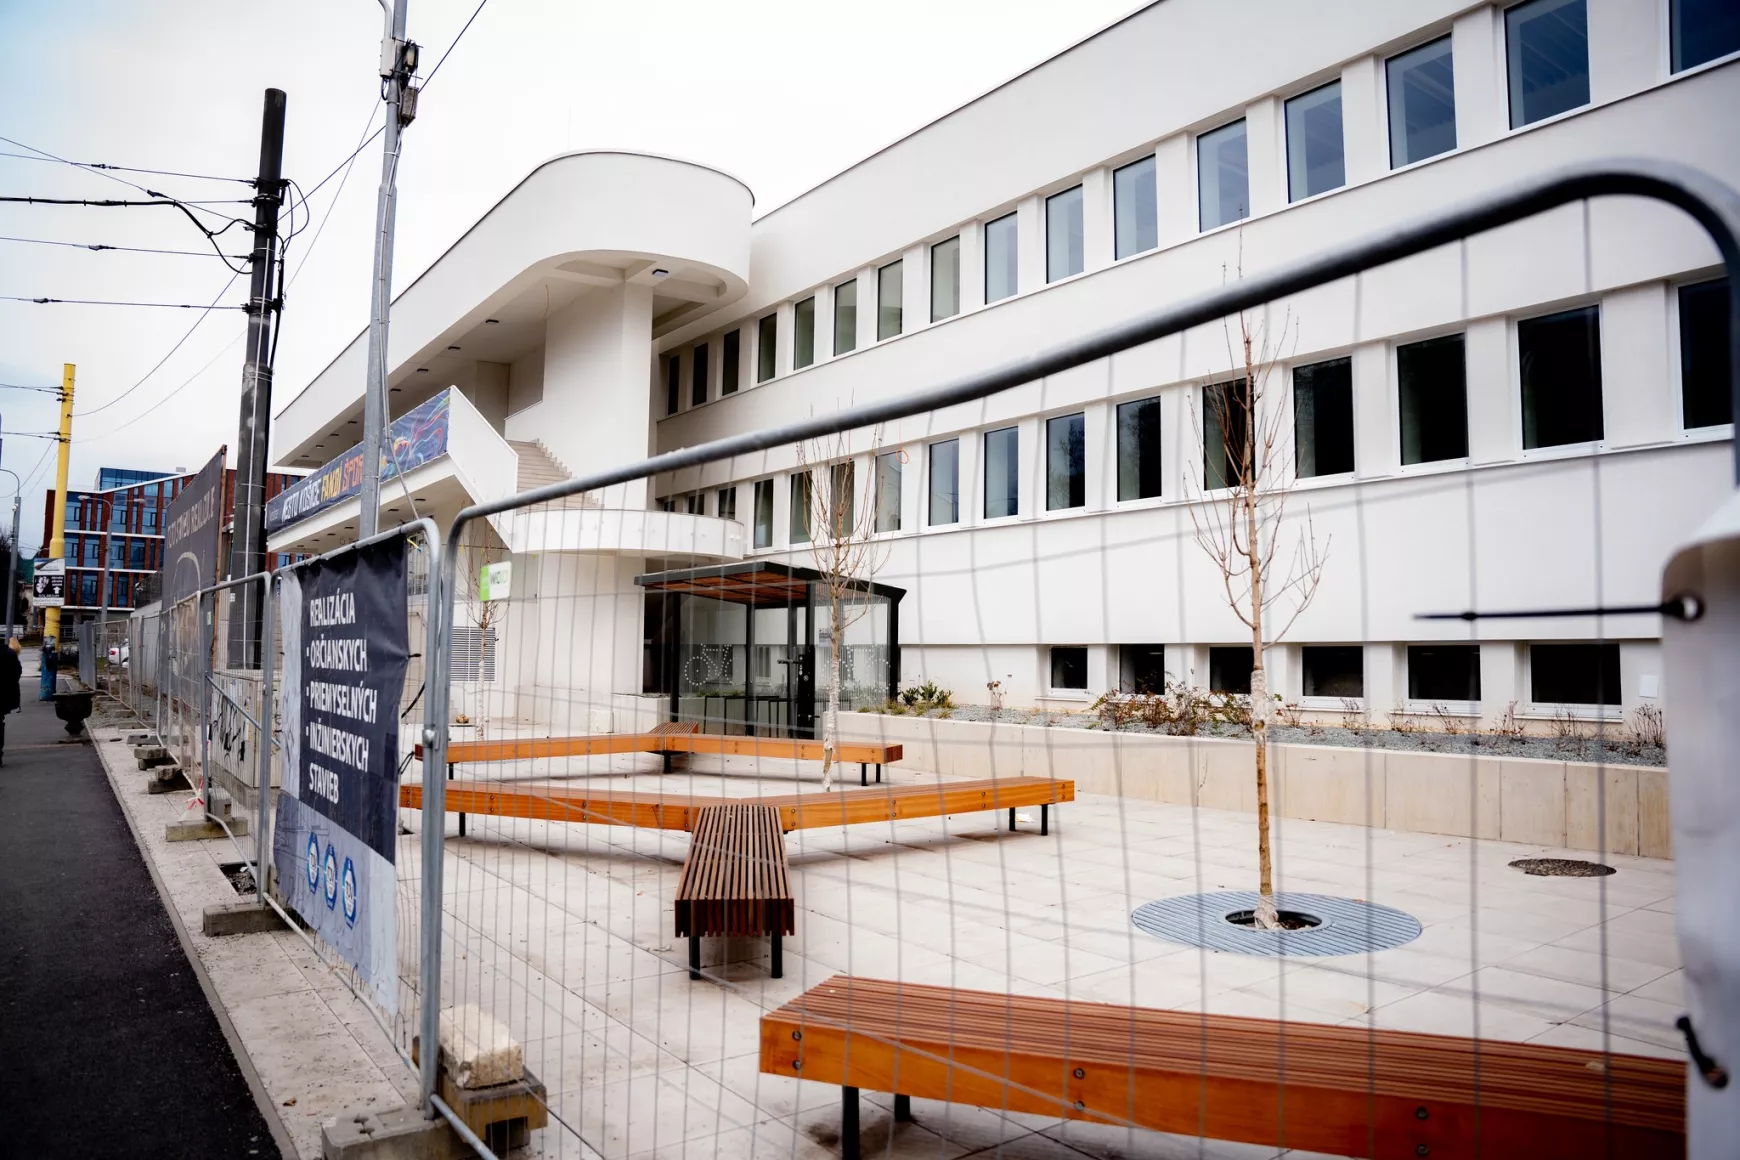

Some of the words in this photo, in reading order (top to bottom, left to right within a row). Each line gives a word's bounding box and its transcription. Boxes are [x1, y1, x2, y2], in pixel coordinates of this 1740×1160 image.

[310, 588, 355, 627] REALIZÁCIA
[310, 633, 368, 671] OBČIANSKYCH
[310, 681, 377, 724] PRIEMYSELNÝCH
[310, 717, 369, 773] INŽINIERSKYCH
[309, 762, 339, 804] STAVIEB
